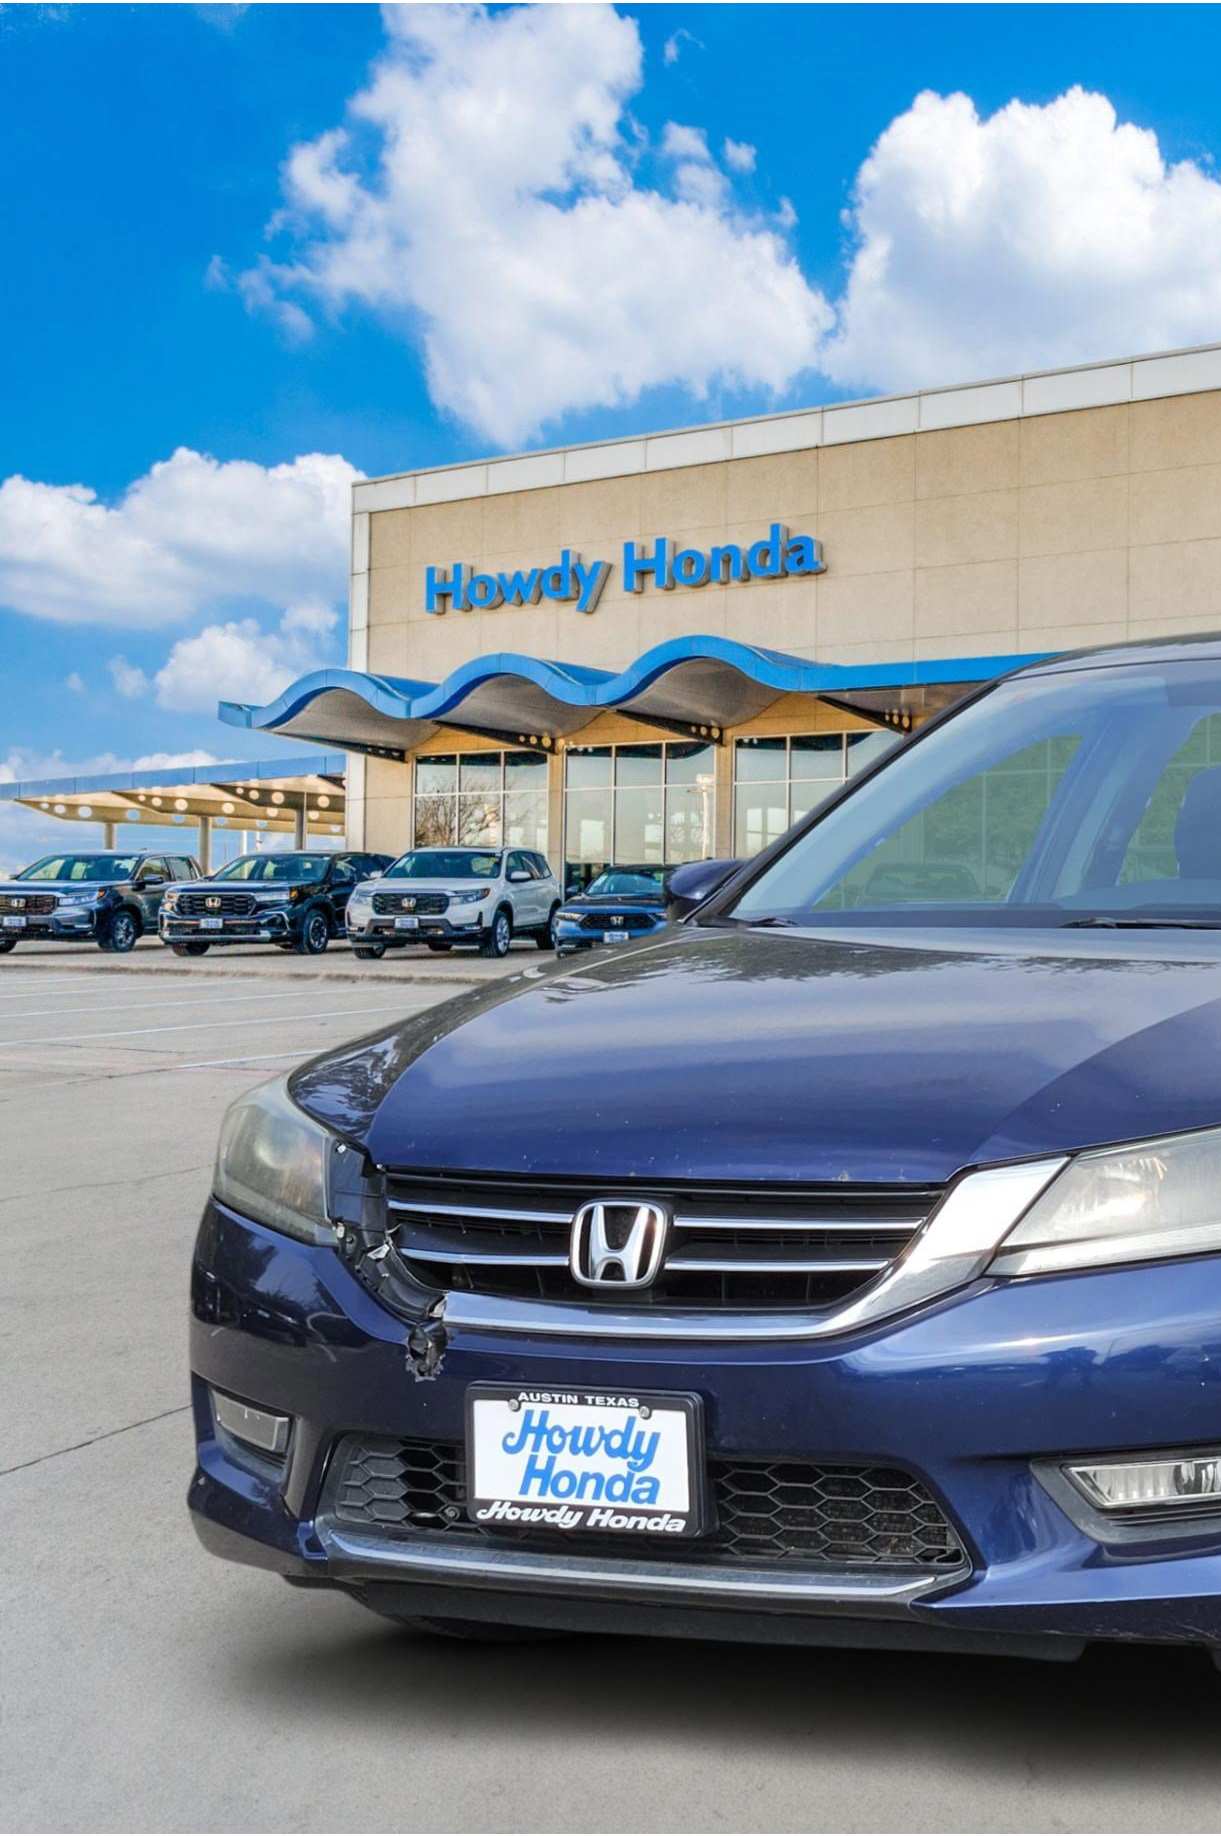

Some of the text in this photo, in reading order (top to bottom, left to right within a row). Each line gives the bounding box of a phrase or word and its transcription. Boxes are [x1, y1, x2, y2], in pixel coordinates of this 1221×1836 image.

[425, 523, 826, 615] Howdy Honda
[517, 1391, 639, 1408] AUSTIN TEXAS
[502, 1409, 661, 1473] Howdy
[518, 1455, 661, 1504] Honda
[476, 1501, 687, 1532] Howdy Honda
